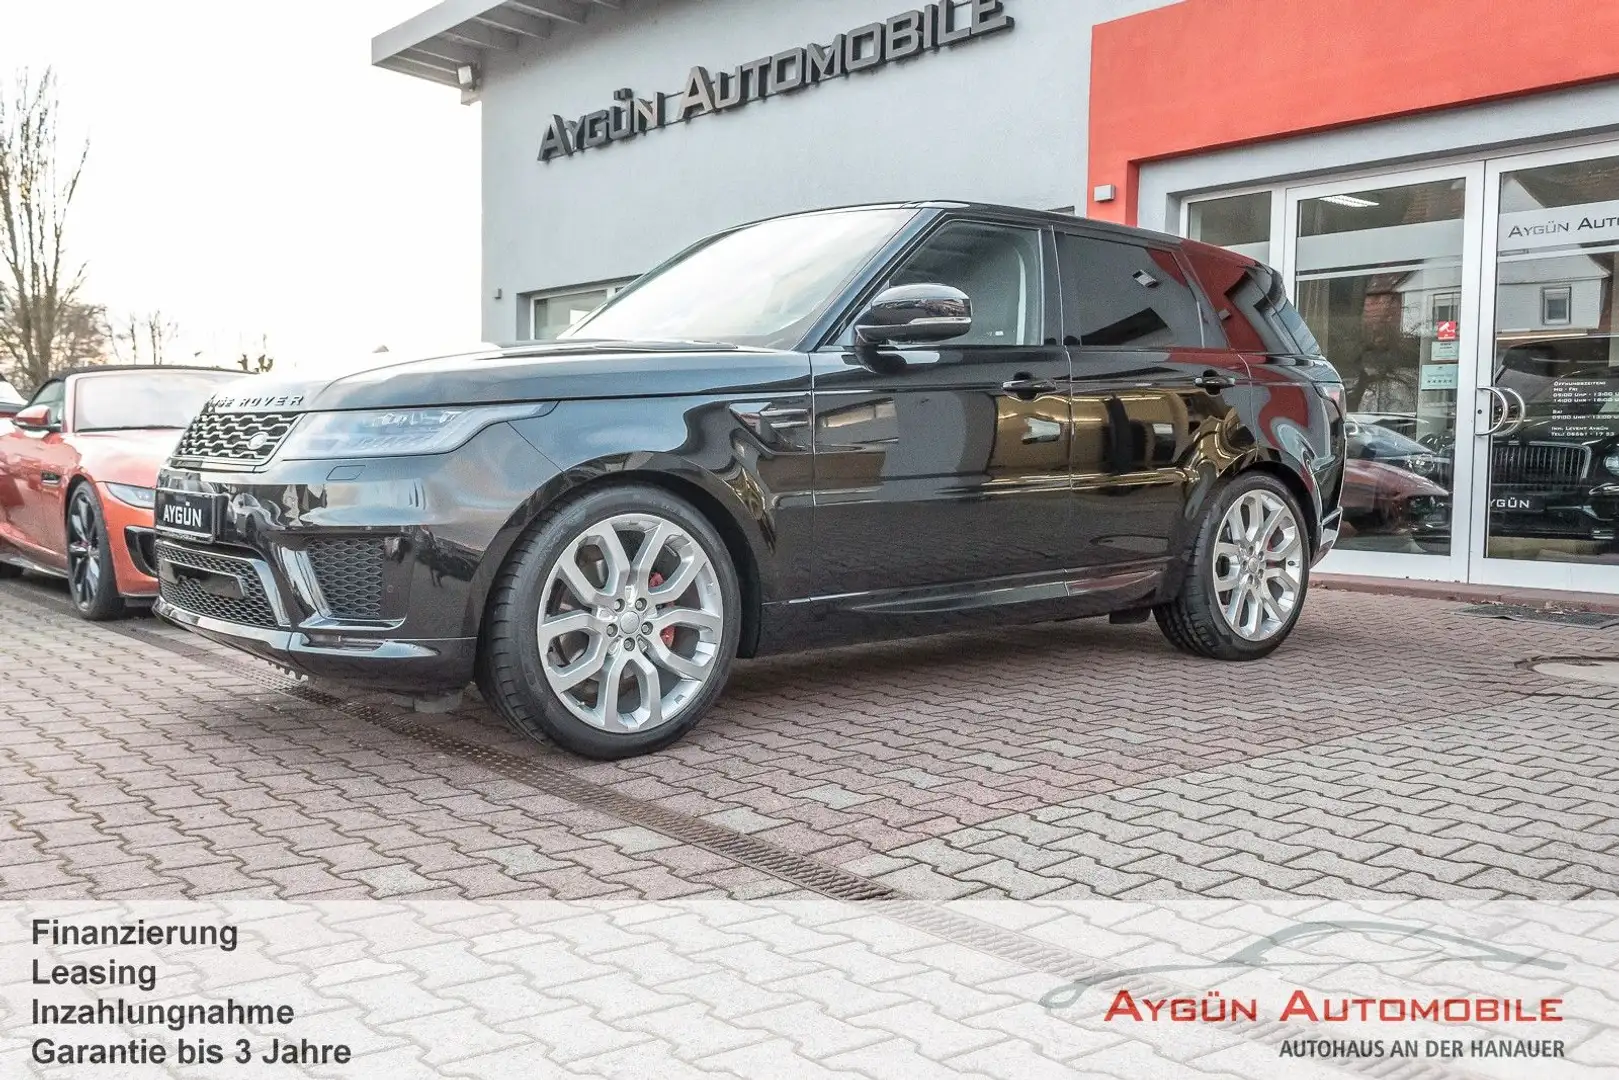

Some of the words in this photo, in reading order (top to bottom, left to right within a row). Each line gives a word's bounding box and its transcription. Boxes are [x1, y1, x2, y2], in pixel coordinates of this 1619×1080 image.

[537, 87, 665, 161] AYGÜN
[676, 0, 1015, 120] AUTOMOBILE
[1508, 220, 1569, 238] AYGÜN
[1577, 217, 1619, 230] AUT
[1490, 496, 1530, 508] YGÜN
[163, 501, 202, 528] AYGÜN
